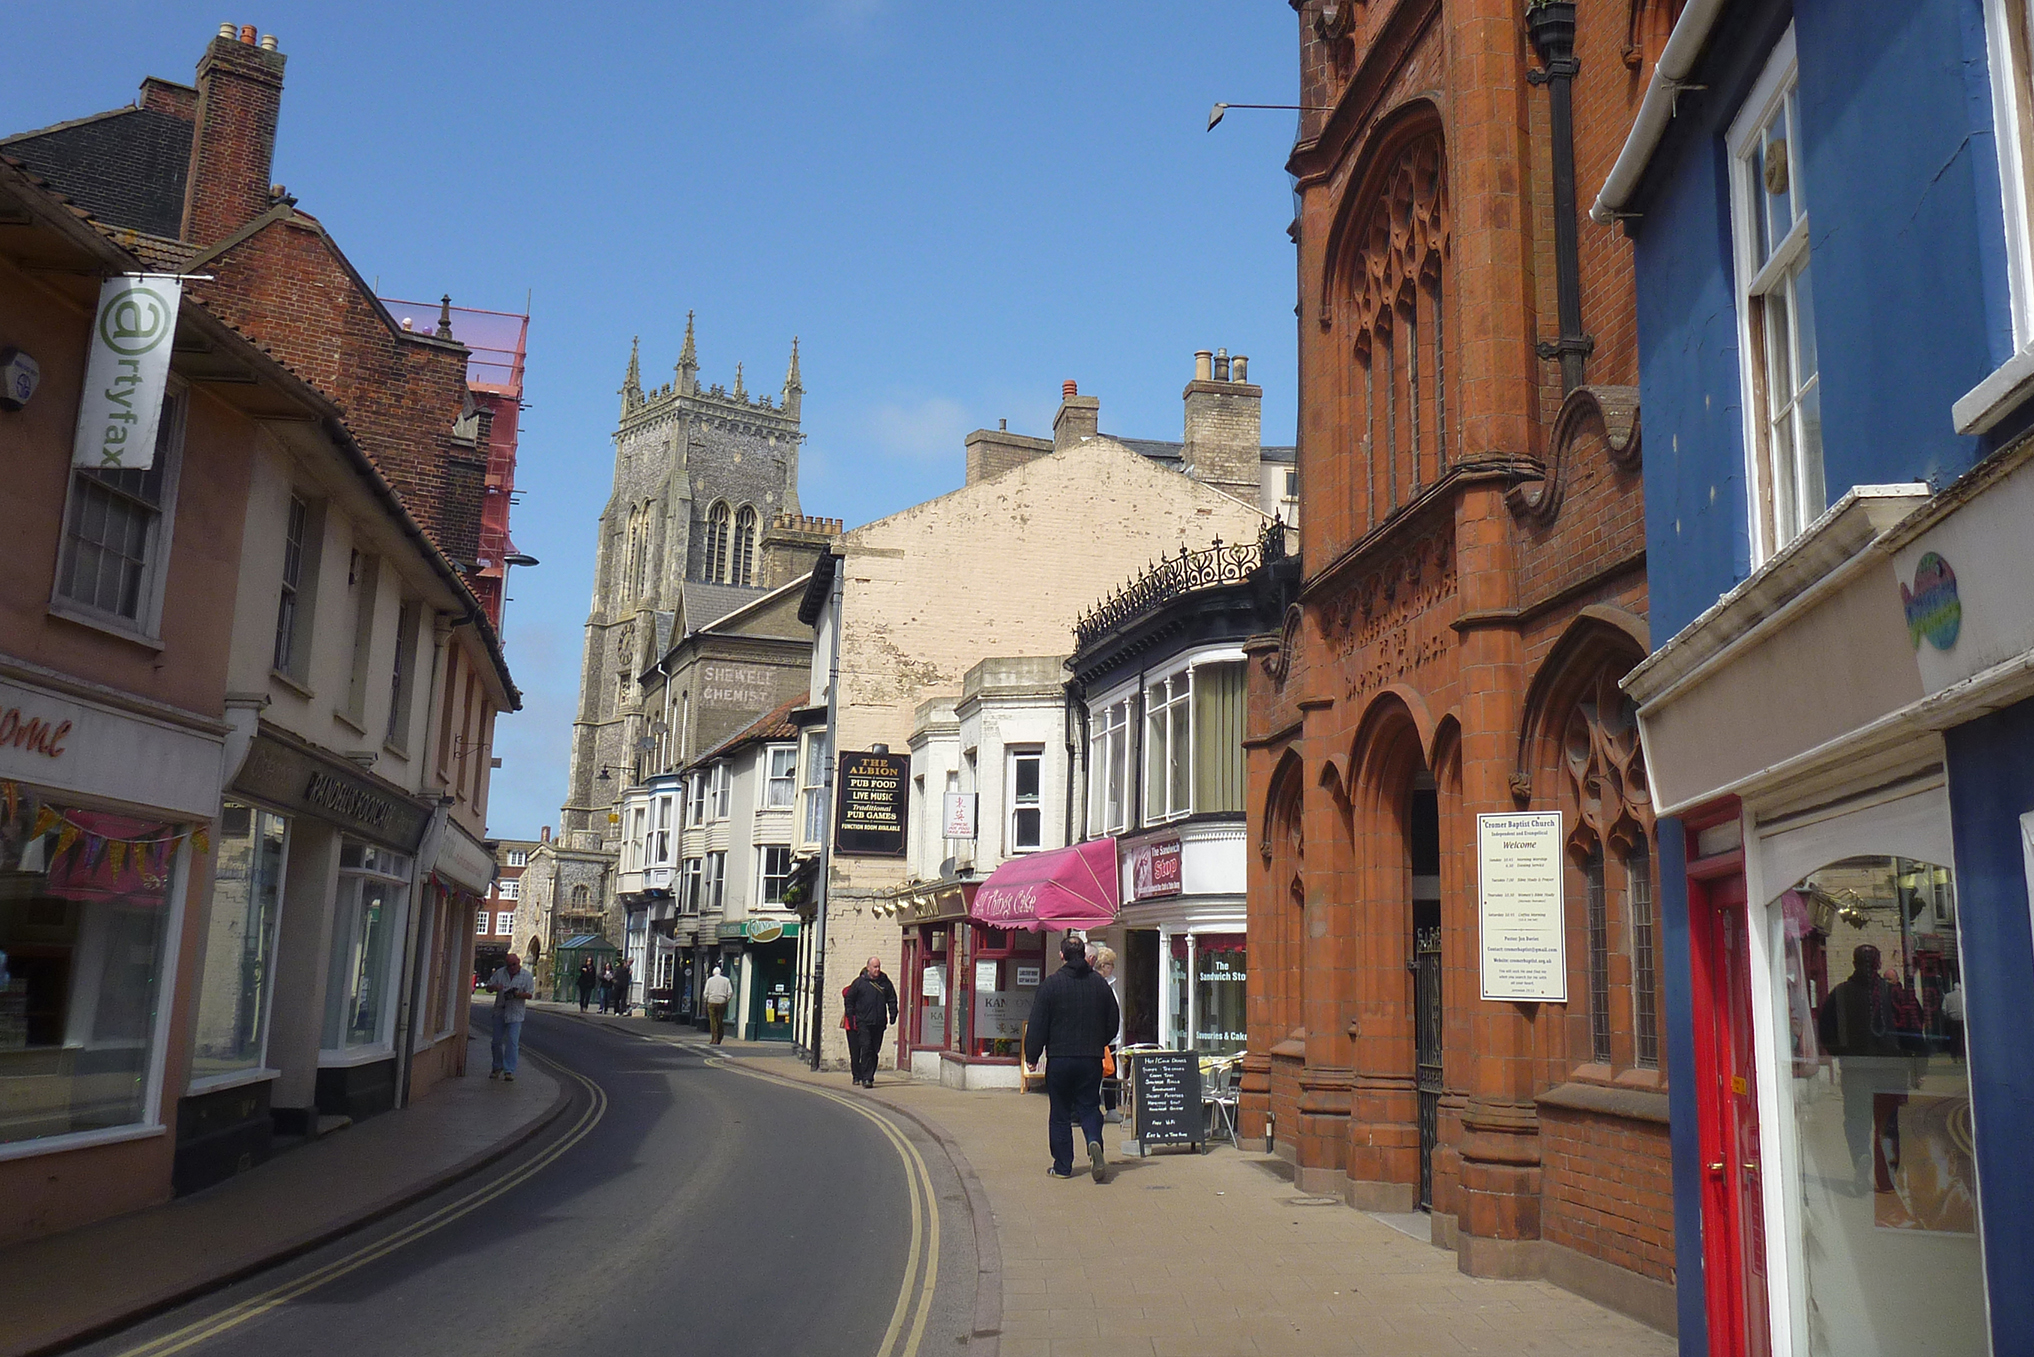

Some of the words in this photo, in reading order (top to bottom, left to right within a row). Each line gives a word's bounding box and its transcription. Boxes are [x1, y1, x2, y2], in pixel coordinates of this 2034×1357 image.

[703, 686, 768, 702] CHEMIST
[0, 706, 73, 757] ome
[861, 759, 888, 767] THE
[849, 767, 898, 776] ALBION
[850, 779, 869, 787] PUB
[871, 780, 897, 789] FOOD
[852, 791, 869, 800] LIVE
[870, 792, 893, 801] MUSIC
[852, 804, 892, 812] Traditional
[866, 812, 897, 820] GAMES
[1484, 821, 1507, 829] Cromer
[1508, 820, 1530, 829] Baptist
[1531, 819, 1555, 827] Church
[1152, 846, 1160, 857] The
[1160, 842, 1180, 856] Sandwich
[1503, 841, 1537, 849] Welcome
[1154, 858, 1178, 879] Stop
[973, 891, 989, 915] All
[987, 889, 1013, 920] Things
[1013, 886, 1037, 914] Cake
[1215, 961, 1229, 970] The
[1199, 971, 1231, 981] Sandwich
[1195, 1030, 1223, 1040] Savouries
[1223, 1031, 1230, 1040] &
